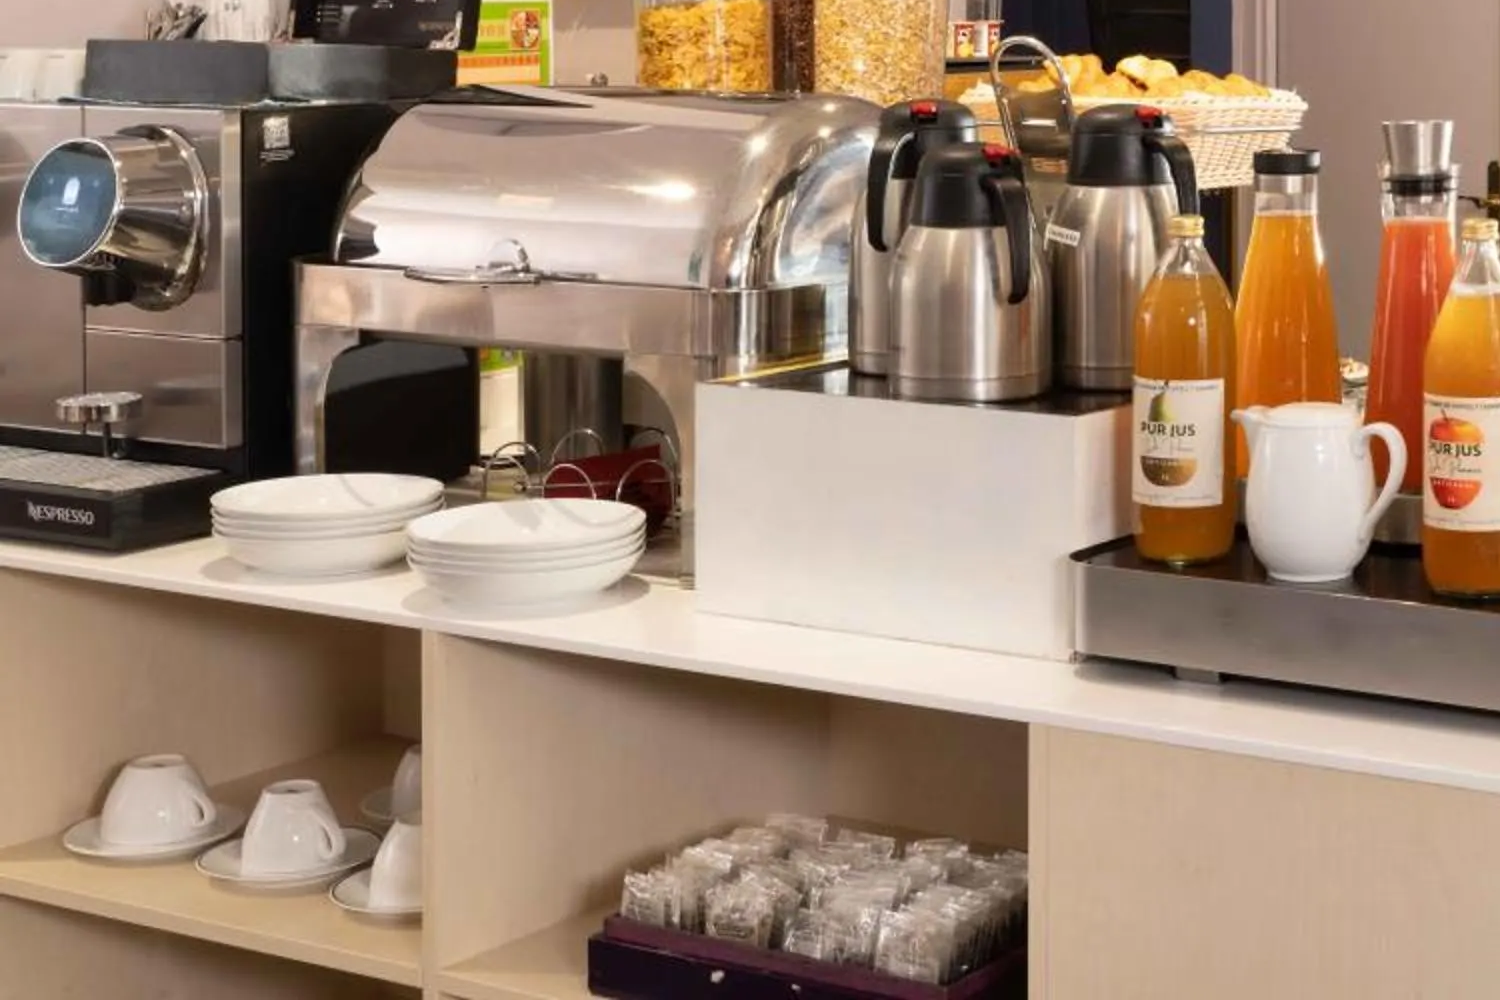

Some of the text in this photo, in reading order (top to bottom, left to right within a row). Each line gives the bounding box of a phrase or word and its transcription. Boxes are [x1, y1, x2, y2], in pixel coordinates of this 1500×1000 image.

[1140, 421, 1197, 438] PUR JUS
[1429, 442, 1482, 459] PUR JUS
[27, 500, 95, 526] NESPRESSO
